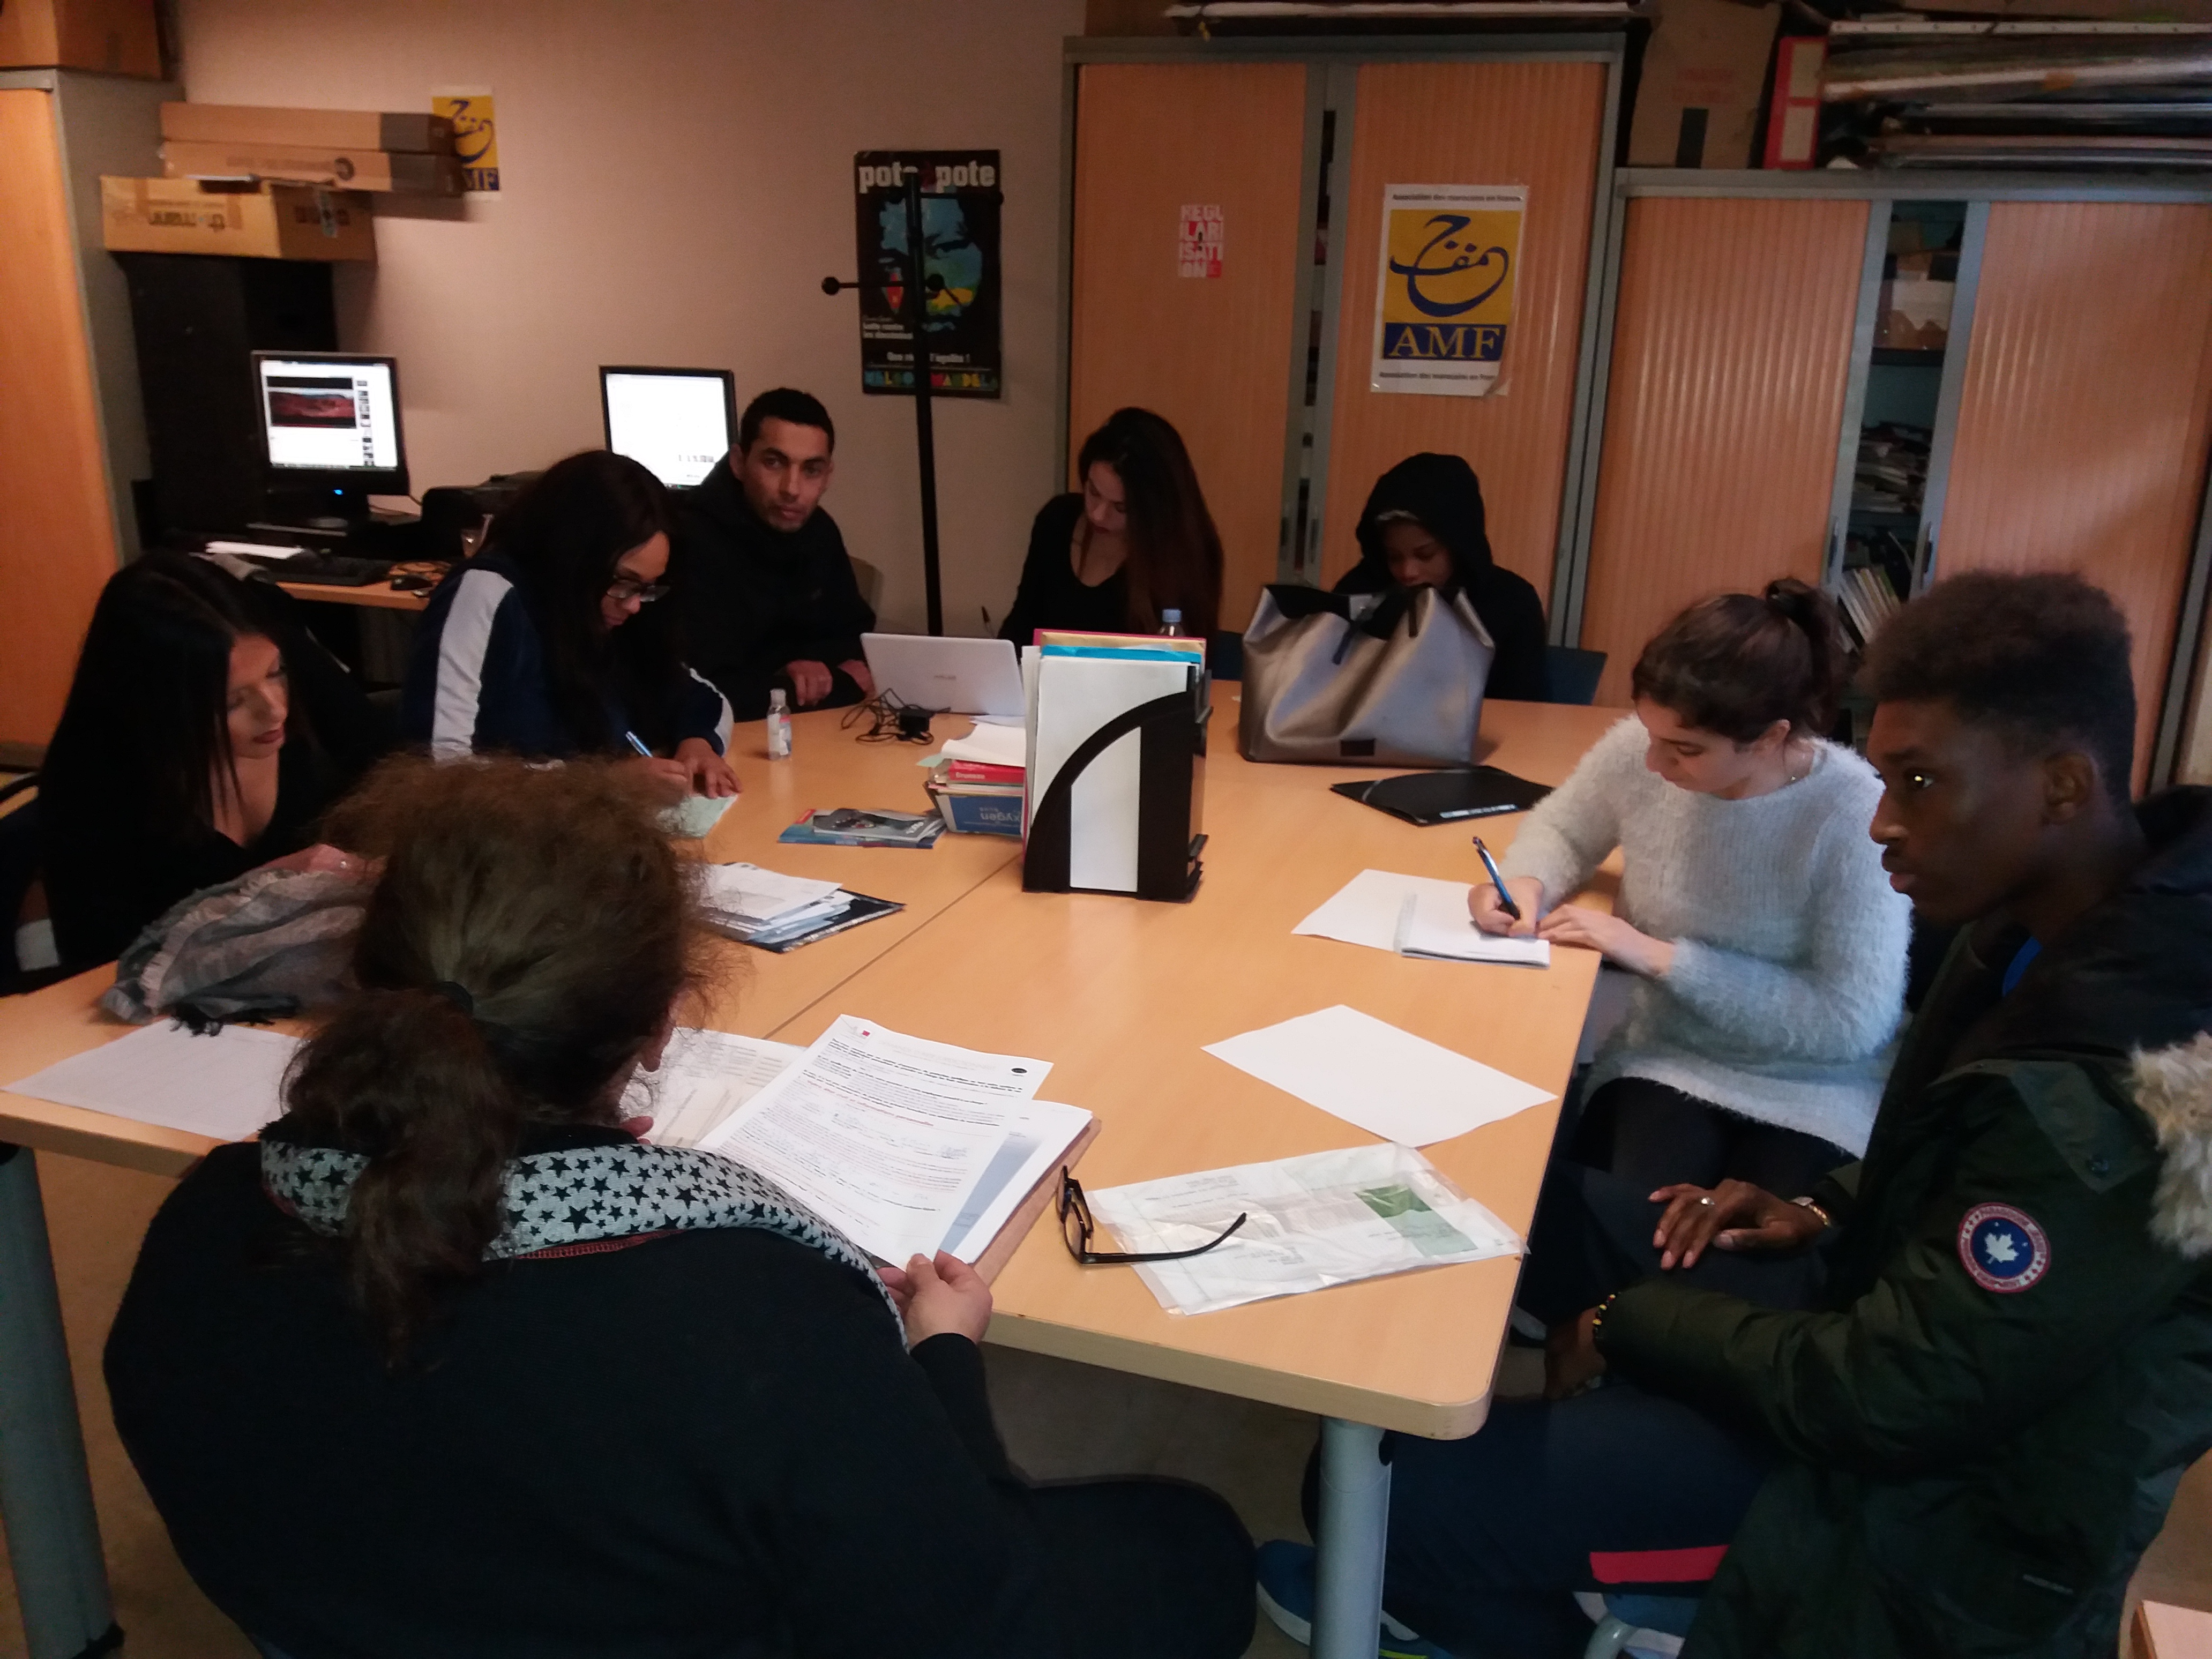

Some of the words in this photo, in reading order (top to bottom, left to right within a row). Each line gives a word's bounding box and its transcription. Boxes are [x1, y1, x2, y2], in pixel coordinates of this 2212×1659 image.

[465, 169, 498, 190] MF
[935, 160, 996, 193] pote
[1389, 326, 1500, 358] AMF
[980, 811, 1021, 821] xygen
